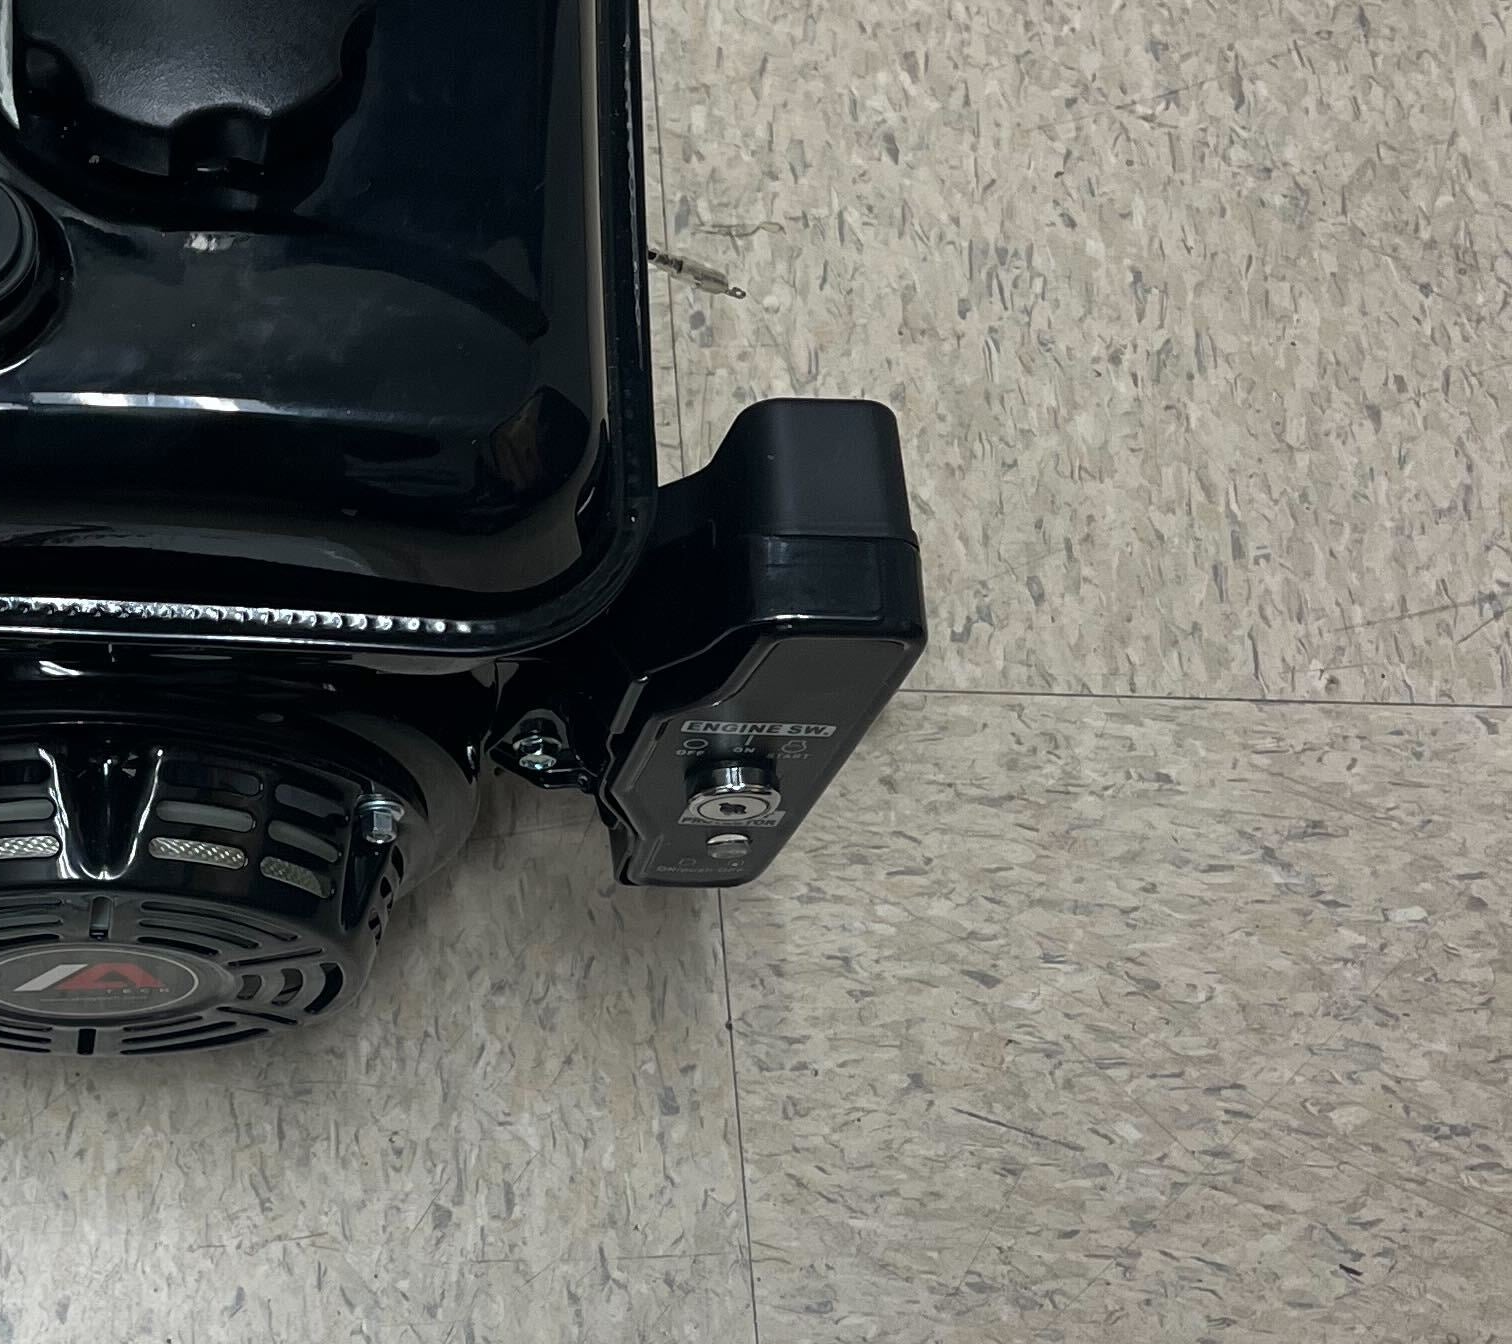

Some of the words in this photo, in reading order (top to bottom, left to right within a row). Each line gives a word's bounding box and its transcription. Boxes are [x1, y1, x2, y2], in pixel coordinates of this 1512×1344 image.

[687, 722, 783, 734] ENGINE
[787, 725, 830, 736] SW.
[675, 749, 706, 757] OFF
